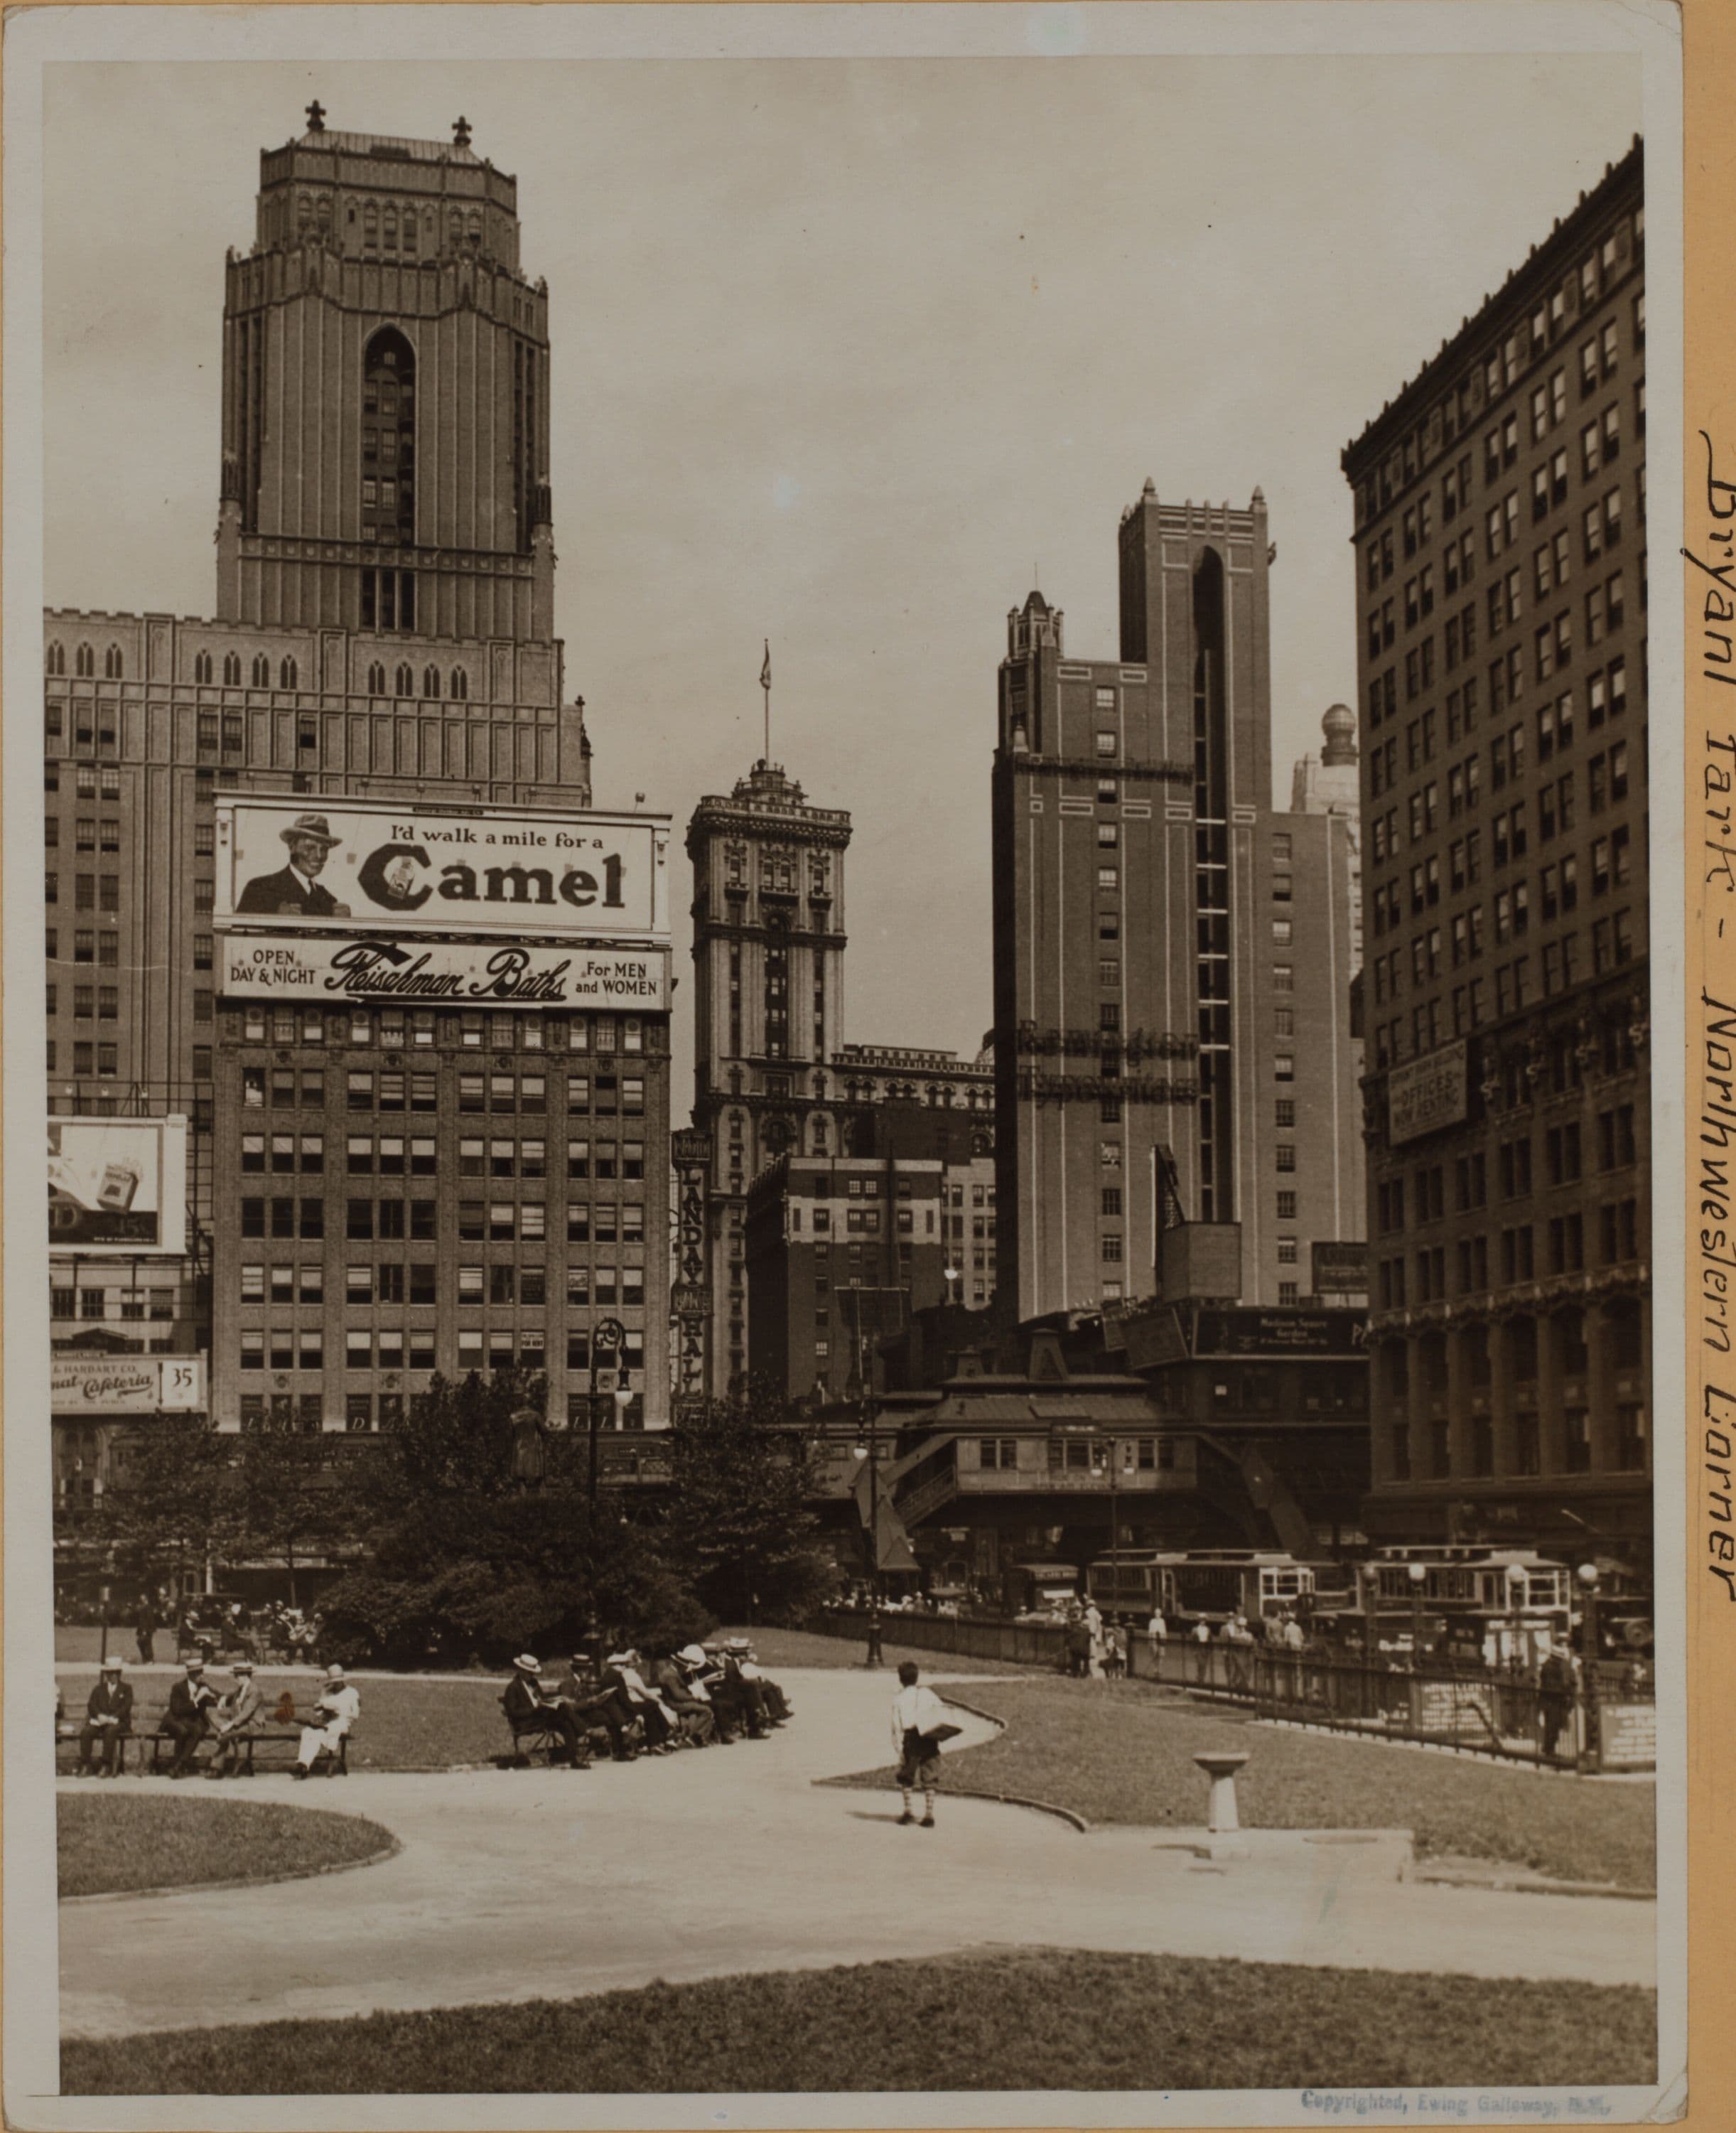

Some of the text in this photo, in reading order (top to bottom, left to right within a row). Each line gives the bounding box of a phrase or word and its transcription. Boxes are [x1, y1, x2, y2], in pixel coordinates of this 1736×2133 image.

[392, 824, 604, 849] I'd walk a mile for a
[357, 844, 625, 910] Camel
[252, 949, 295, 965] OPEN
[587, 961, 646, 977] For MEN
[231, 967, 319, 986] DAY & NIGHT
[468, 947, 571, 996] Baths
[576, 979, 657, 995] and WOMEN
[681, 1168, 703, 1286] LANDAY
[681, 1320, 703, 1396] HALL
